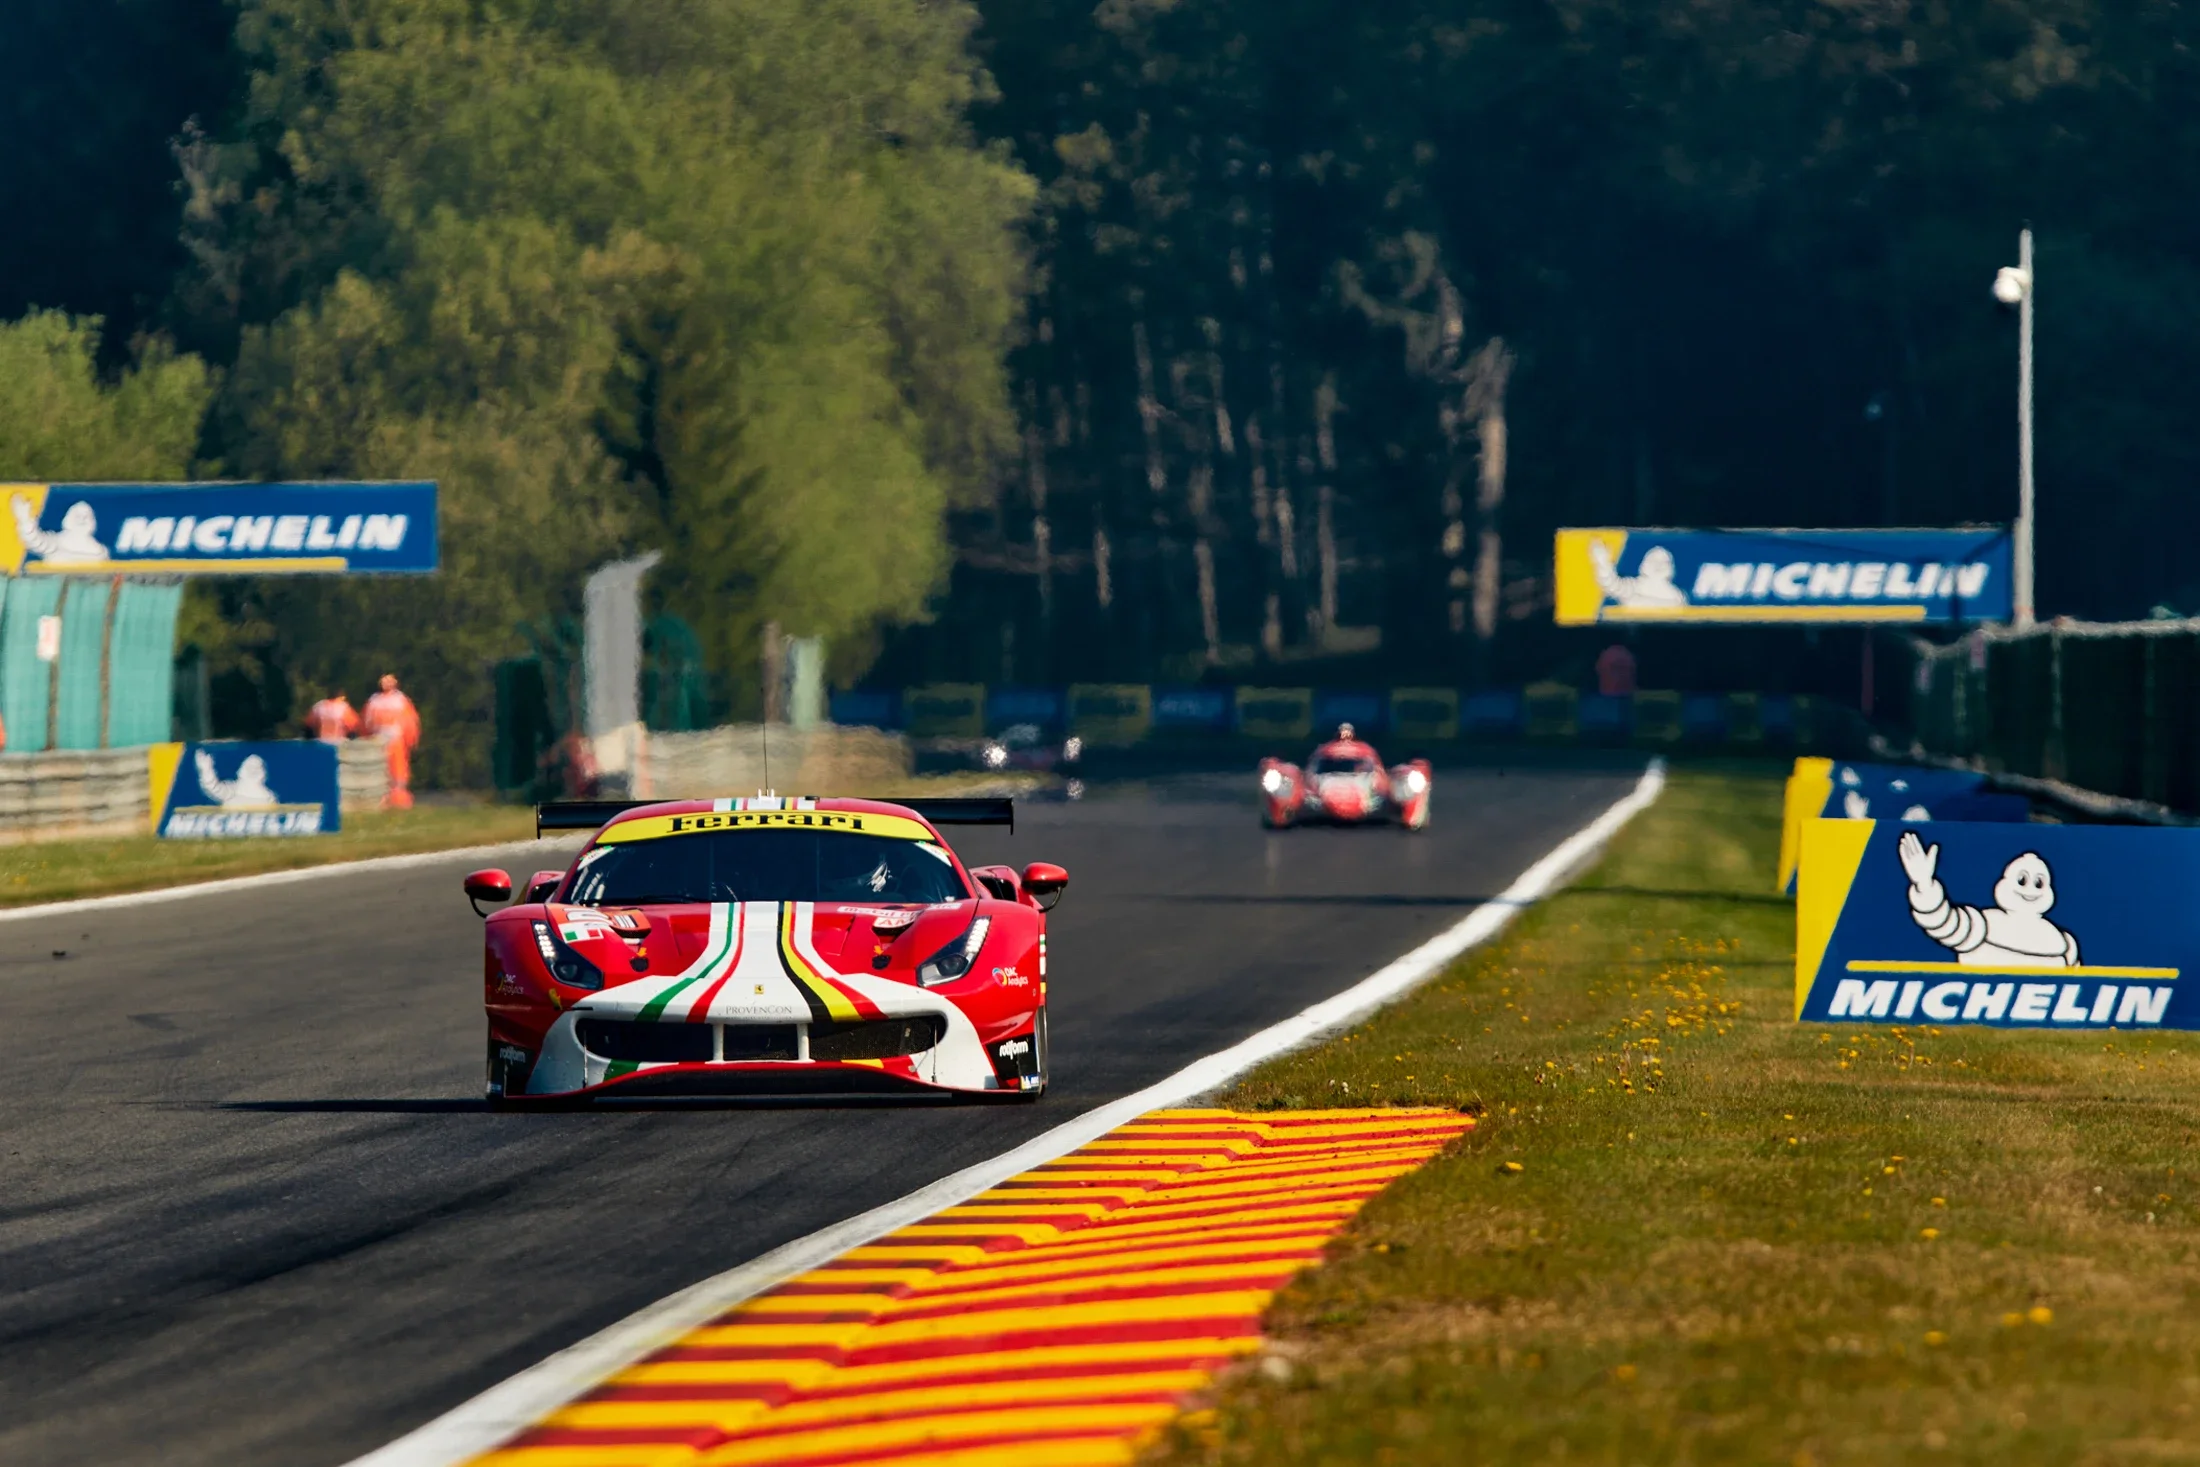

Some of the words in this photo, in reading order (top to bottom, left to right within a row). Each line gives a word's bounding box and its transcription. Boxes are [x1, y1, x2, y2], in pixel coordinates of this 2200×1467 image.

[115, 514, 409, 552] MICHELIN
[1692, 562, 1989, 599] MICHELIN
[165, 811, 324, 838] MICHELIN
[666, 812, 865, 834] Ferrari
[1827, 978, 2173, 1024] MICHELIN
